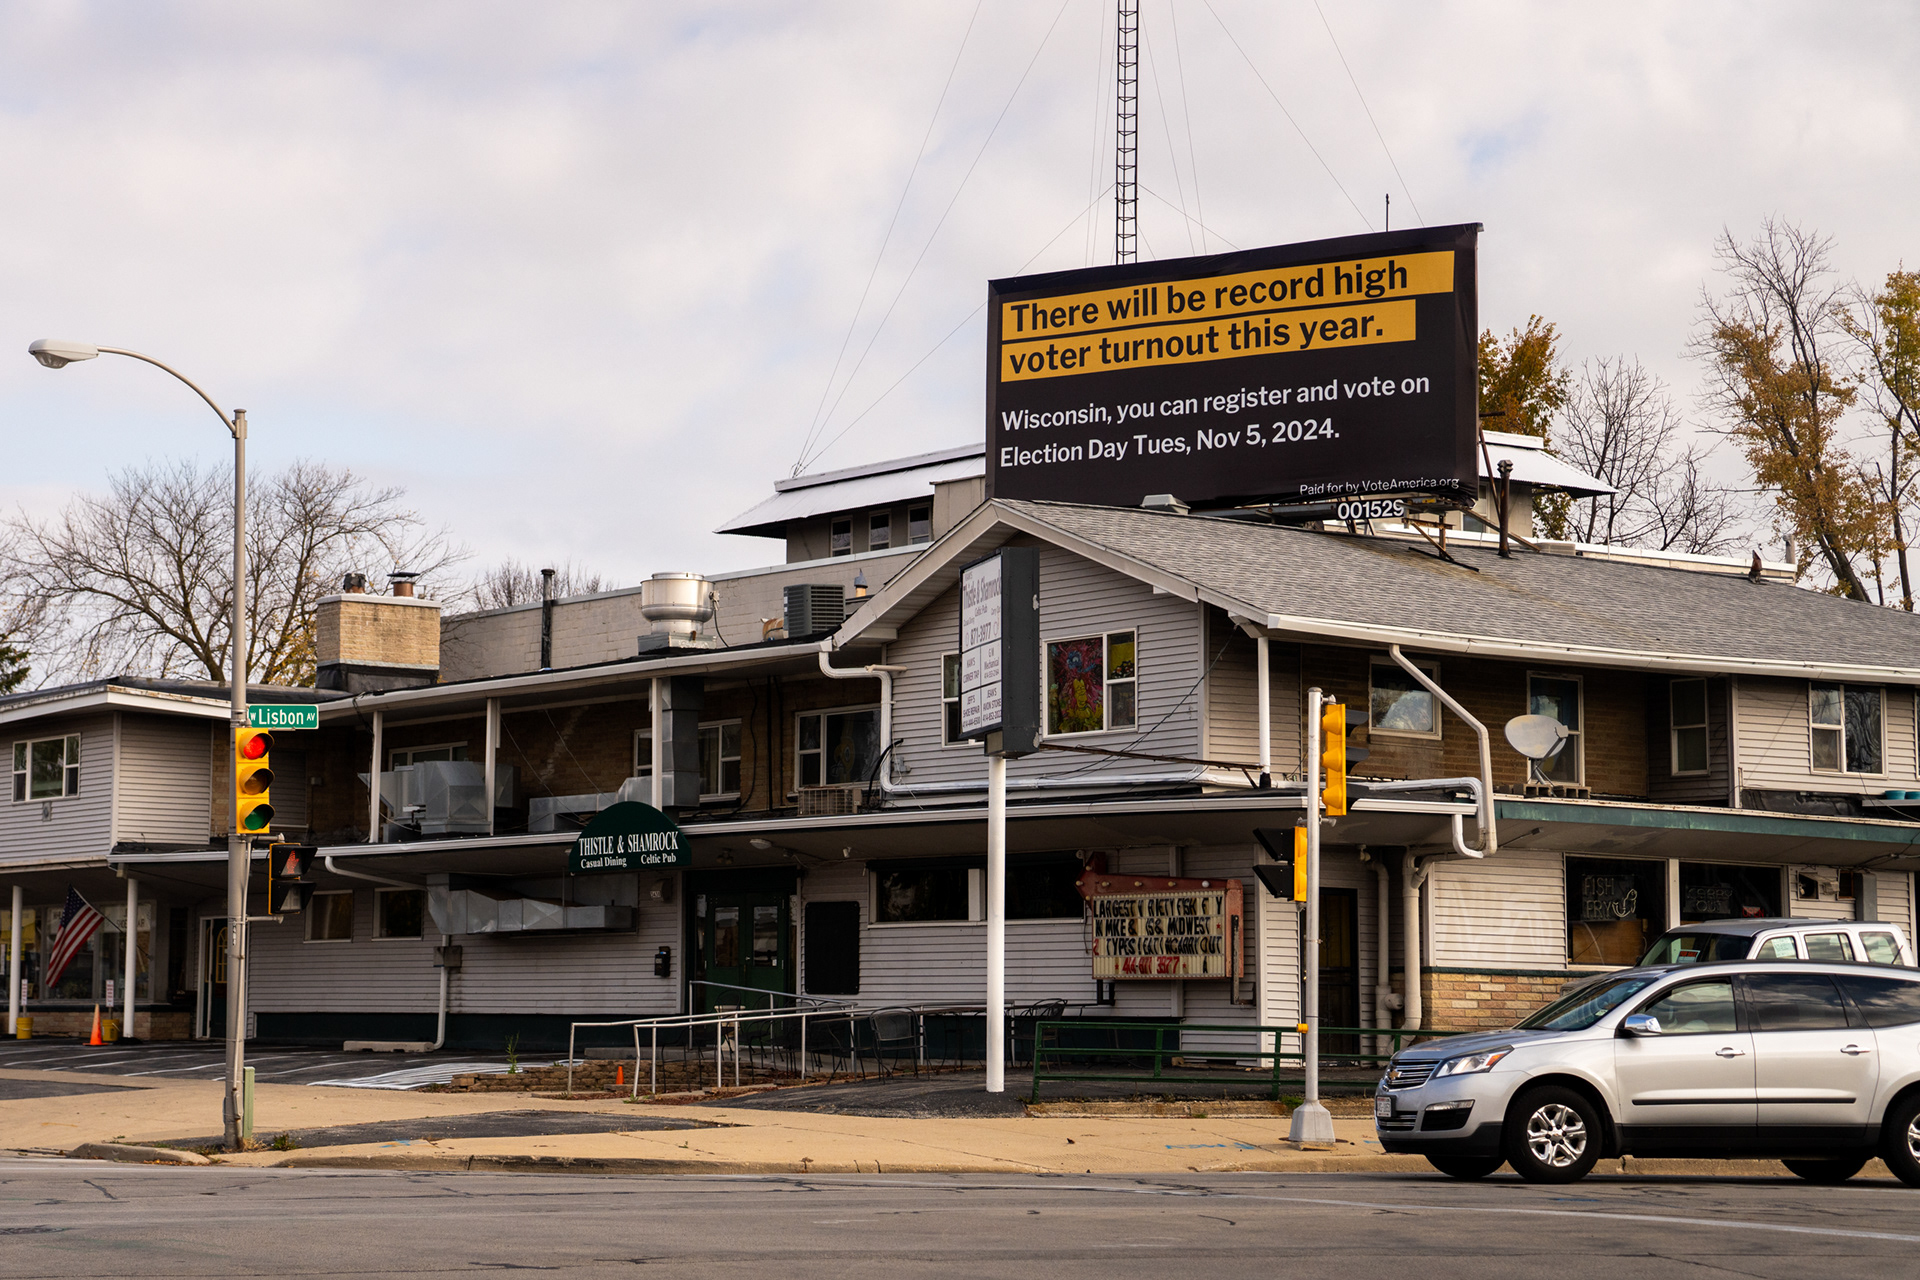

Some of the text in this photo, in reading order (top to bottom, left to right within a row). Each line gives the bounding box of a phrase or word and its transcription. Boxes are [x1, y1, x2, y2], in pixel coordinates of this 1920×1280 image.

[1010, 260, 1407, 332] There will be record high
[1010, 315, 1383, 374] voter turnout this year.
[1002, 376, 1430, 430] Wisconsin, you can register and vote on
[1001, 418, 1340, 468] Election Day Tues, Nov 5, 2024.
[1300, 477, 1460, 495] Paid for by VoteAmerica.org
[1338, 499, 1404, 520] 001529
[970, 622, 991, 646] 871-3977
[250, 708, 315, 725] W Lisbon AV
[580, 831, 679, 856] THISTLE & SHAMROCK
[581, 856, 627, 868] Casual Dining
[641, 853, 676, 864] Celtic Pub
[1584, 877, 1615, 896] FISH
[1687, 888, 1732, 900] CARRY
[1093, 900, 1136, 918] LARGEST
[1177, 898, 1198, 916] FISH
[1216, 896, 1222, 914] Y
[1586, 901, 1612, 920] FRY
[1696, 900, 1722, 913] OUT
[1742, 906, 1764, 918] OPEN
[1105, 919, 1126, 936] MKE
[1128, 920, 1138, 936] &
[1167, 917, 1210, 935] MIDWEST
[1093, 938, 1099, 956] 2
[1200, 936, 1222, 954] OUT
